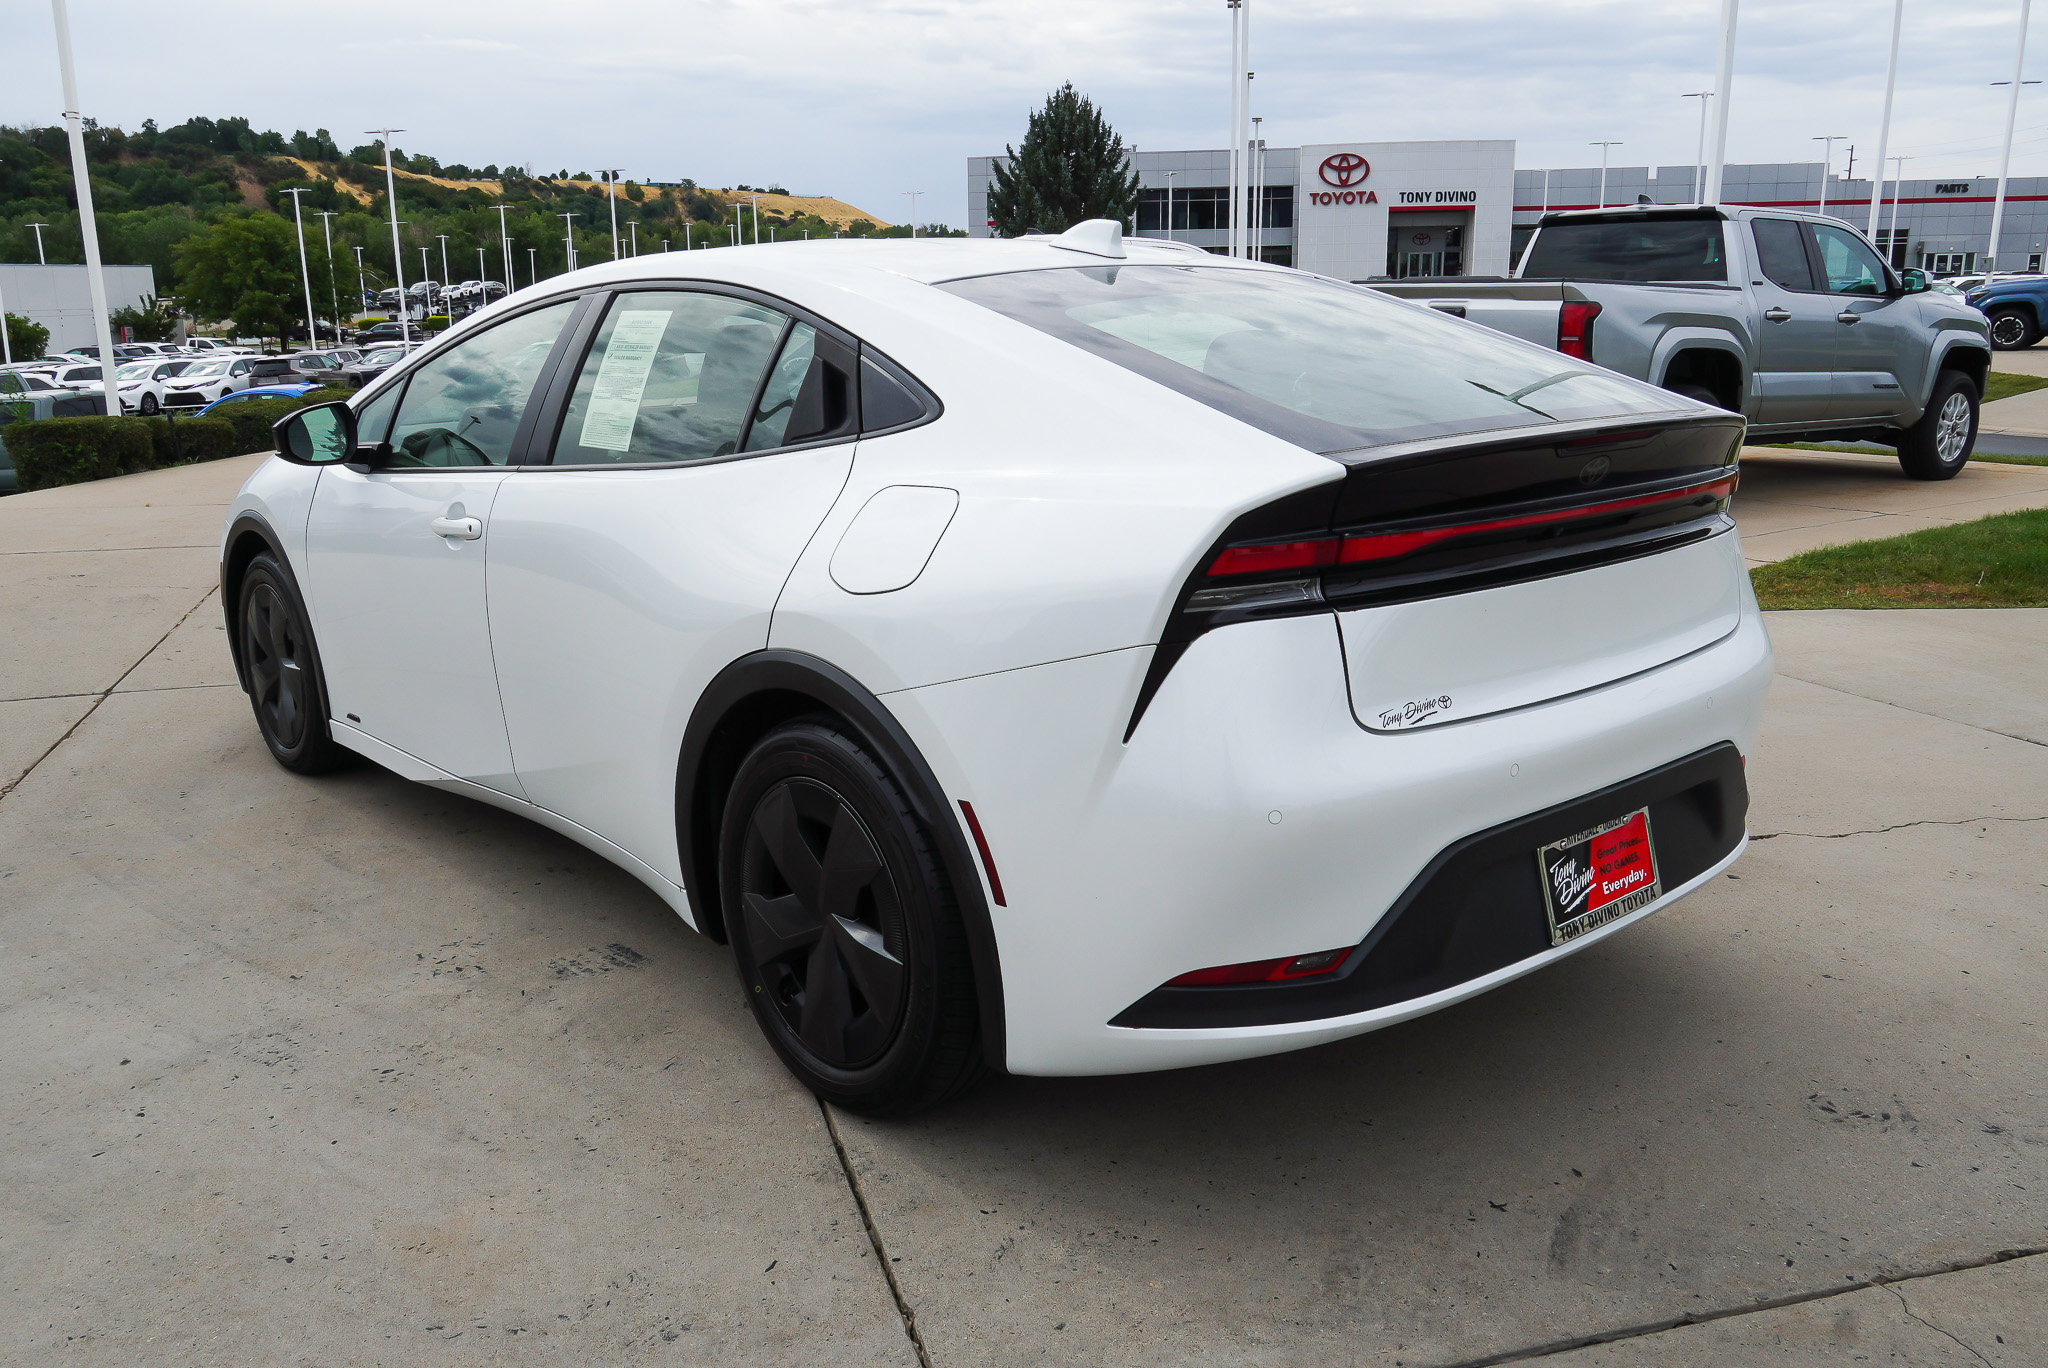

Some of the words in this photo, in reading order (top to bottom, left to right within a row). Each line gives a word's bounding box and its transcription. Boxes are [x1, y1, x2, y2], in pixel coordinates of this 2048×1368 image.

[1309, 190, 1378, 206] TOYOTA
[1399, 191, 1432, 204] TONY
[1435, 190, 1477, 203] DIVINO
[1935, 183, 1970, 194] PARTS
[1378, 708, 1403, 728] Tony
[1403, 698, 1438, 719] Divino
[1596, 845, 1617, 860] Great
[1550, 856, 1577, 887] Tony
[1599, 863, 1612, 876] NO
[1556, 866, 1596, 905] Divino
[1602, 867, 1647, 895] Everyday.
[1560, 918, 1587, 942] TONY
[1588, 905, 1620, 929] DIVINO
[1621, 887, 1657, 911] TOYOTA
